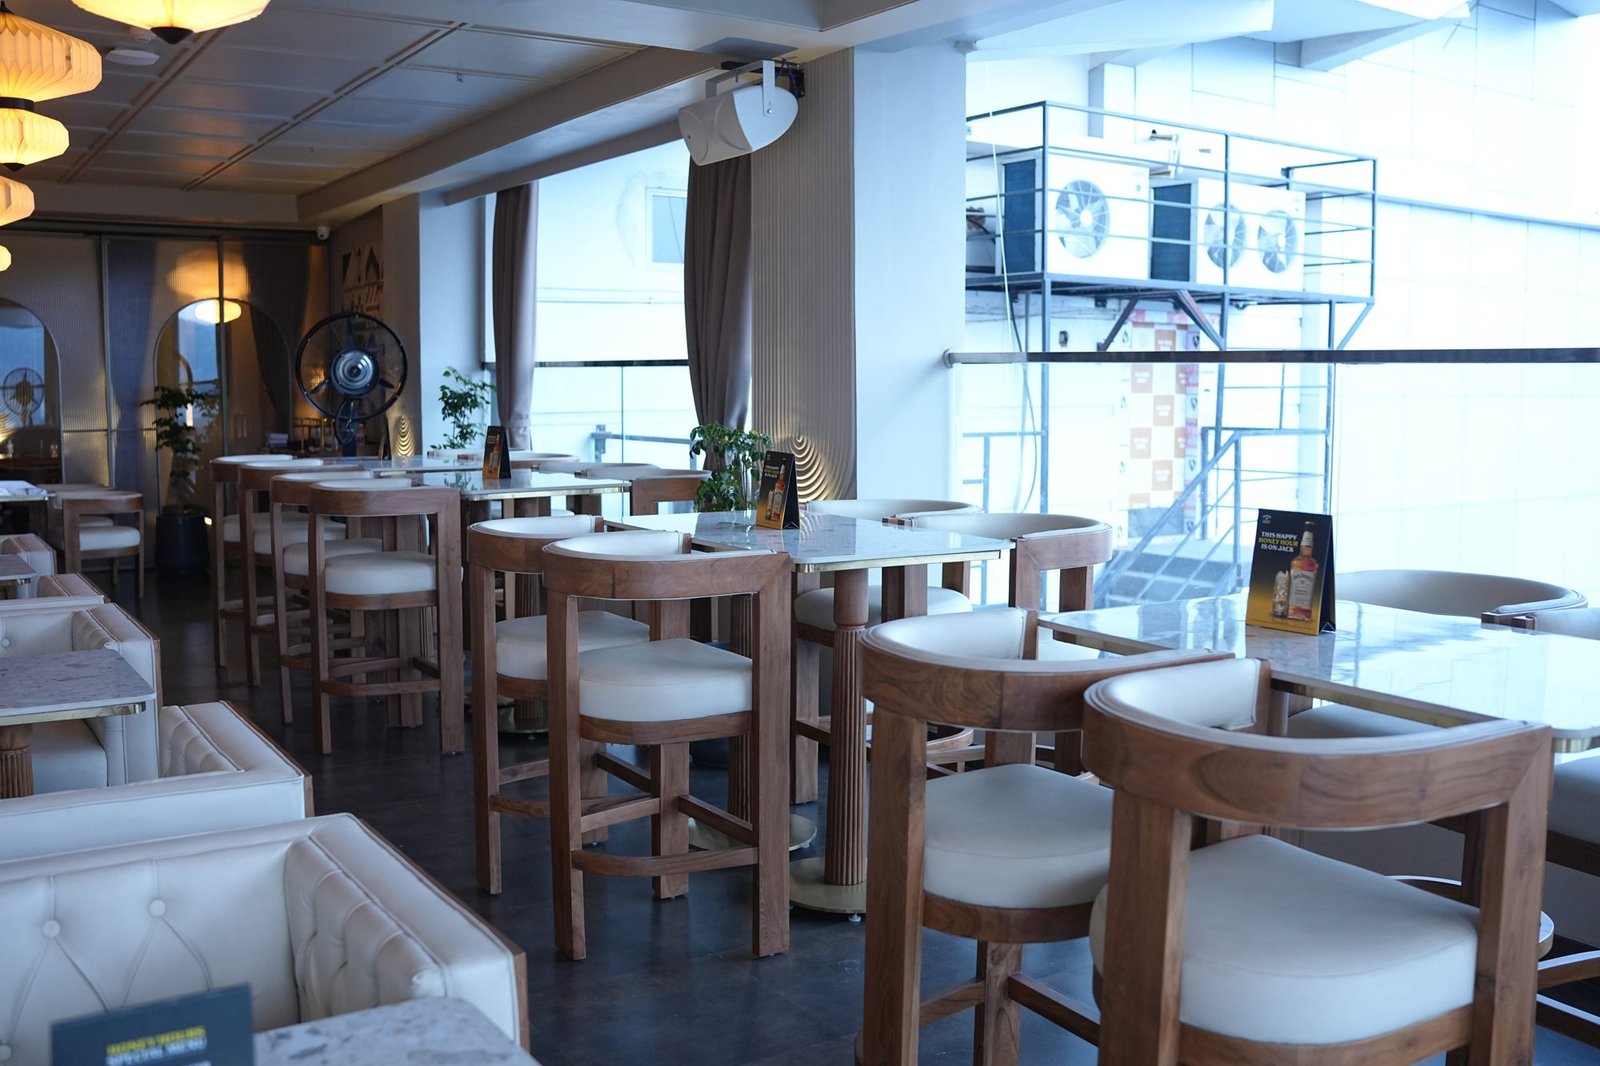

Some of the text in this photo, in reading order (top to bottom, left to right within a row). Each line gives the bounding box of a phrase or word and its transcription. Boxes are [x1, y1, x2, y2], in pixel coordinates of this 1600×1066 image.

[1261, 531, 1276, 539] THIS
[1259, 537, 1298, 547] HONEY HOUR
